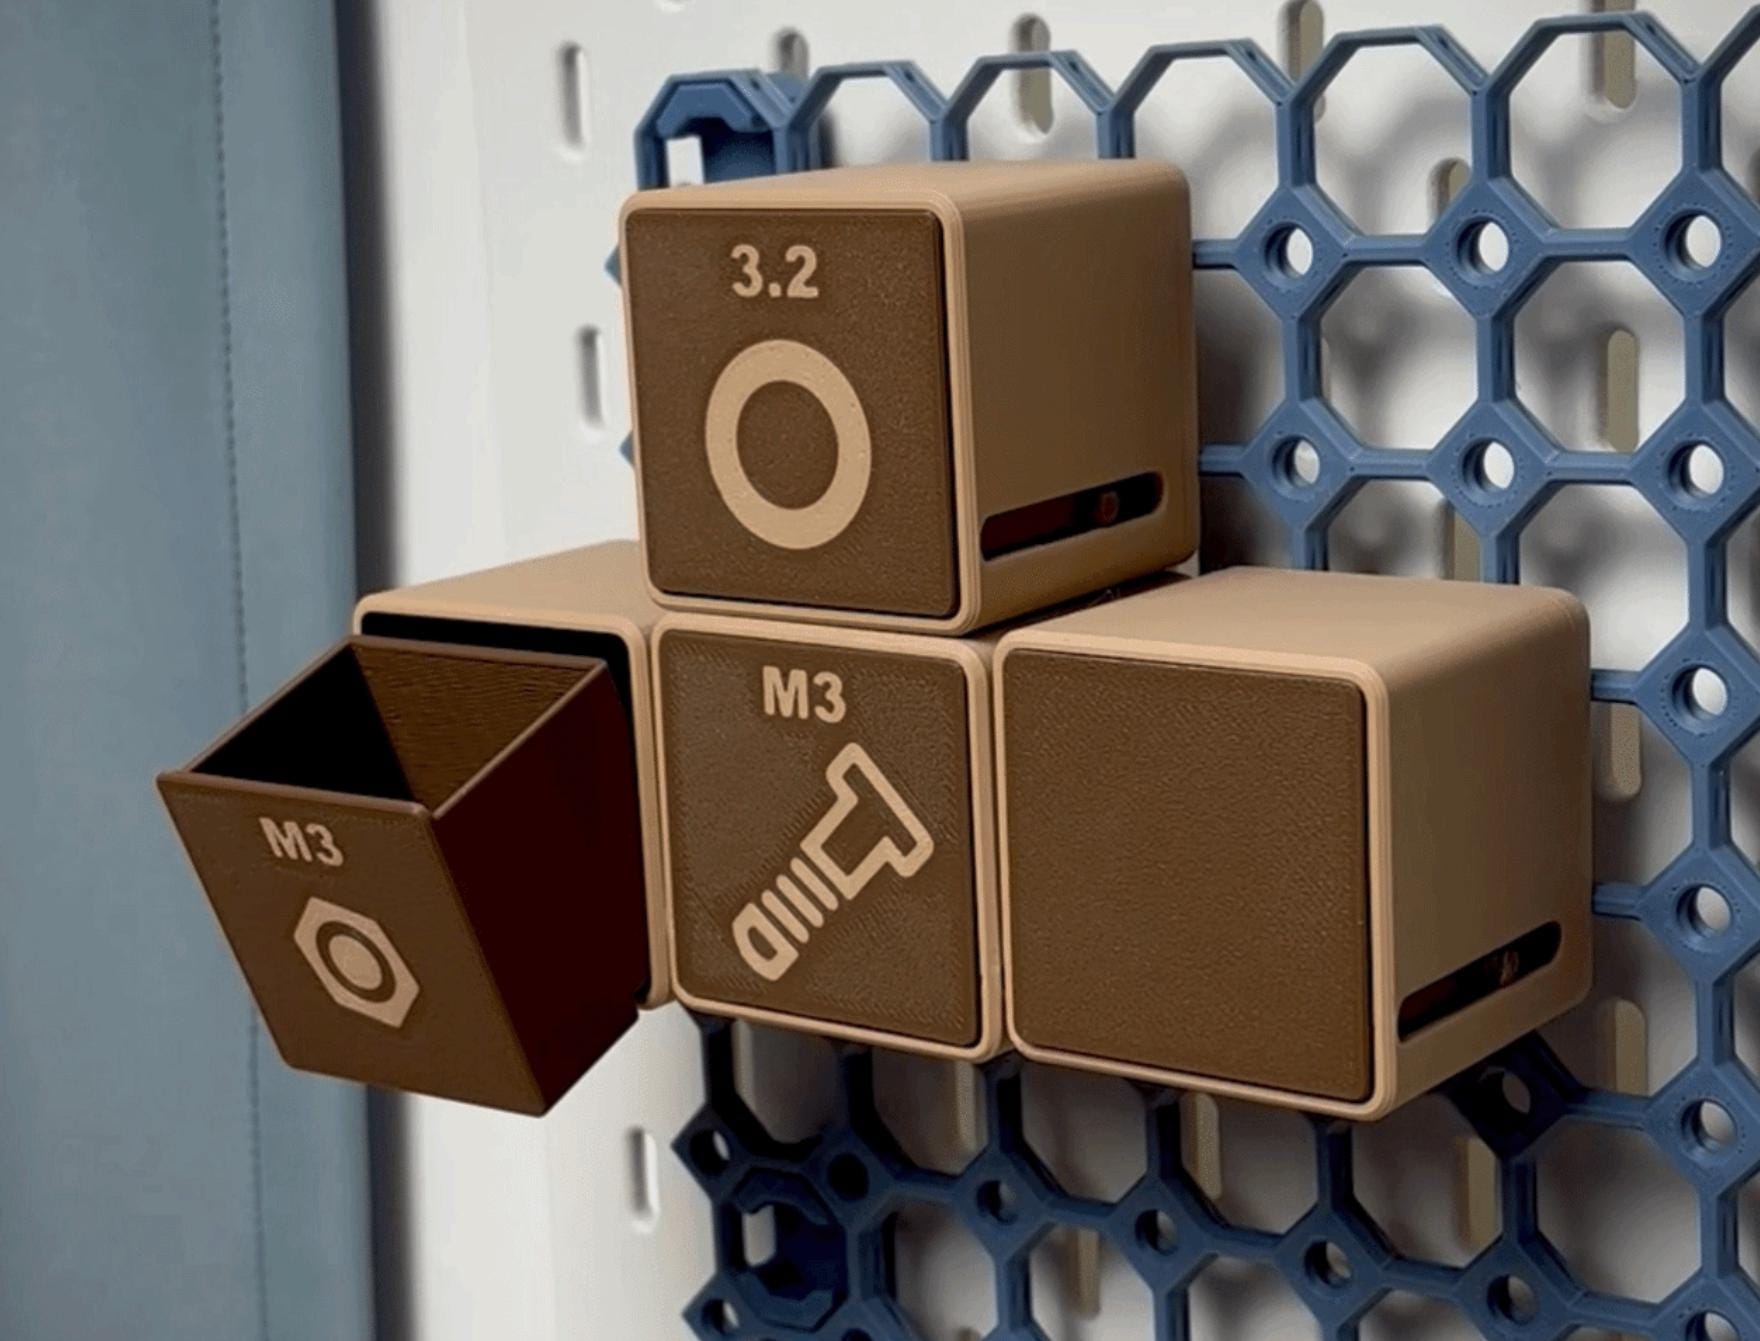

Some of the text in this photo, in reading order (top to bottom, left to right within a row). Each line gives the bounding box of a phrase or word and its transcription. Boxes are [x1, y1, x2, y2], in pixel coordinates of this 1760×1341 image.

[730, 244, 819, 299] 3.2
[762, 665, 847, 723] M3
[259, 817, 344, 868] M3
